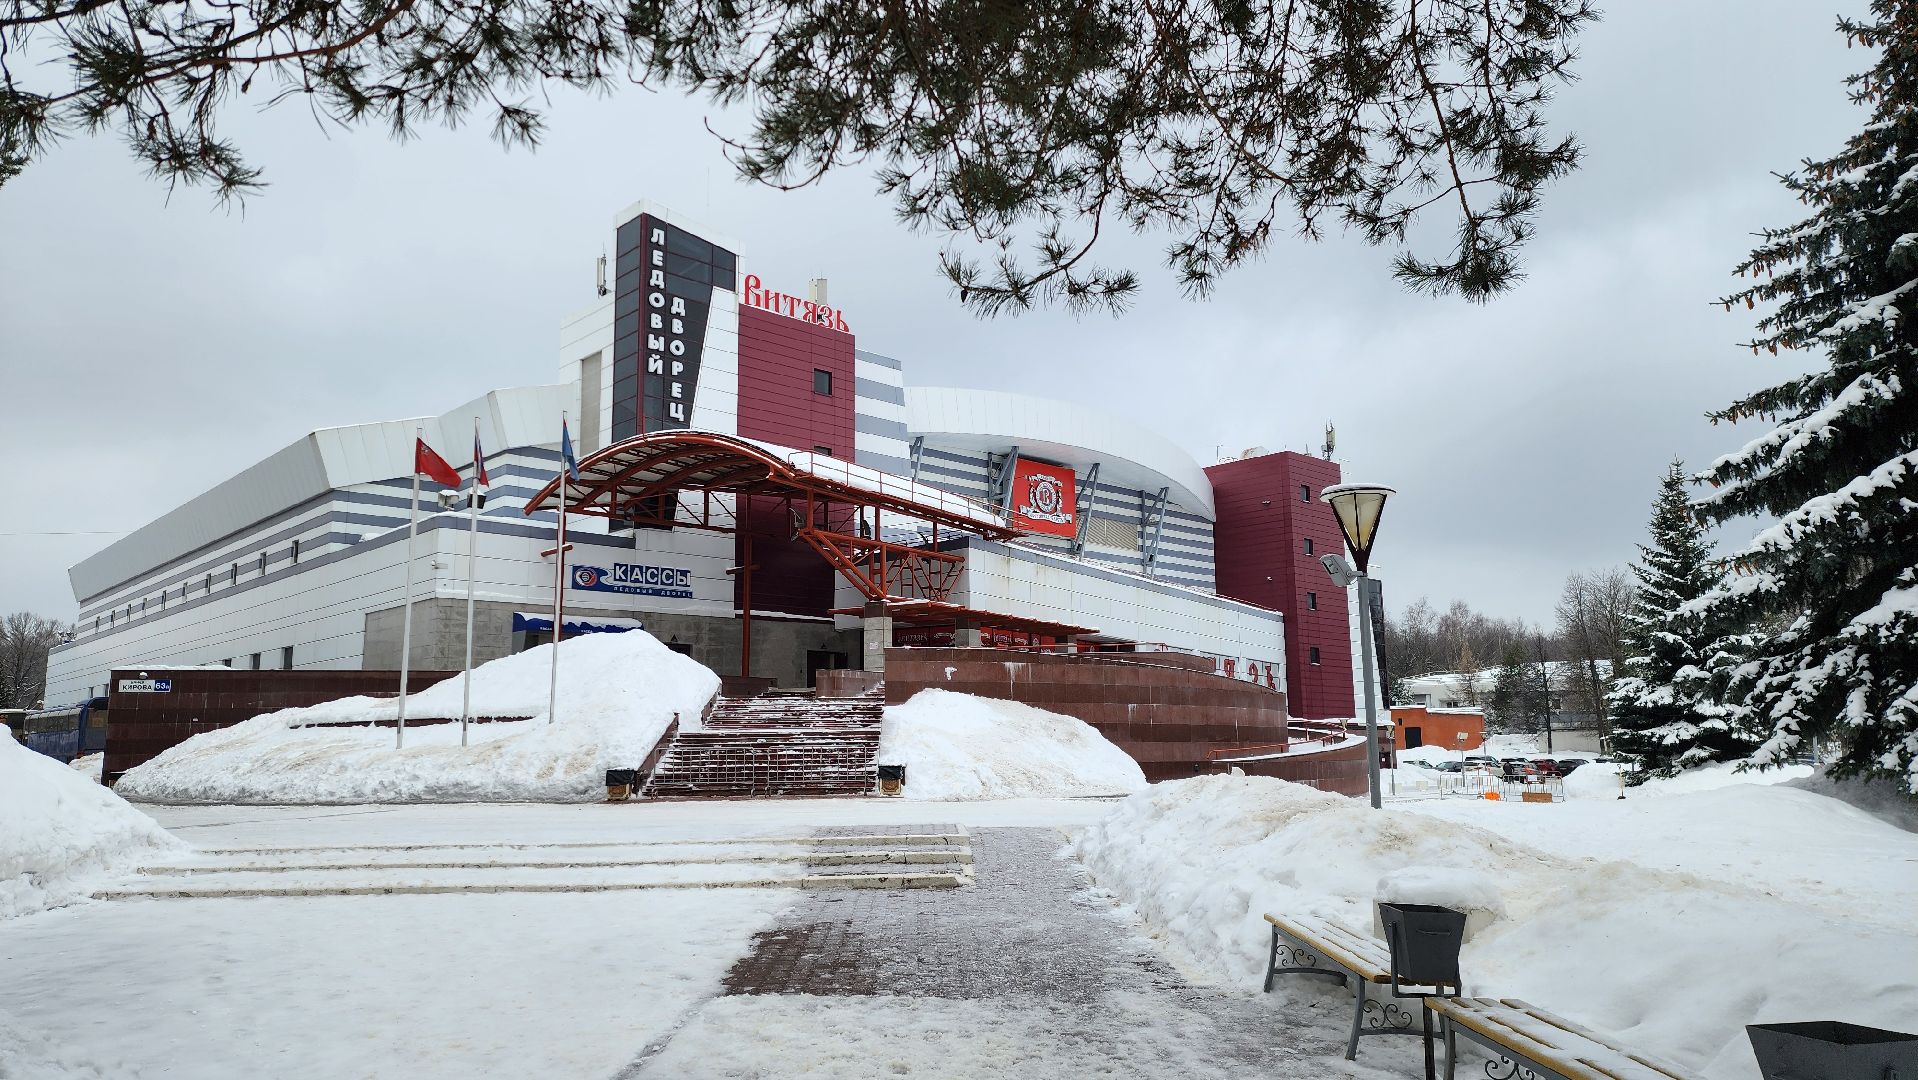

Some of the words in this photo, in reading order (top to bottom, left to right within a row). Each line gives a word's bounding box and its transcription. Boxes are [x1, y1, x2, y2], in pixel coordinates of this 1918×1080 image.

[648, 228, 665, 375] ЛЕДОВЫЙ
[669, 297, 685, 422] ДВОРЕЦ
[615, 565, 691, 586] КАССЫ
